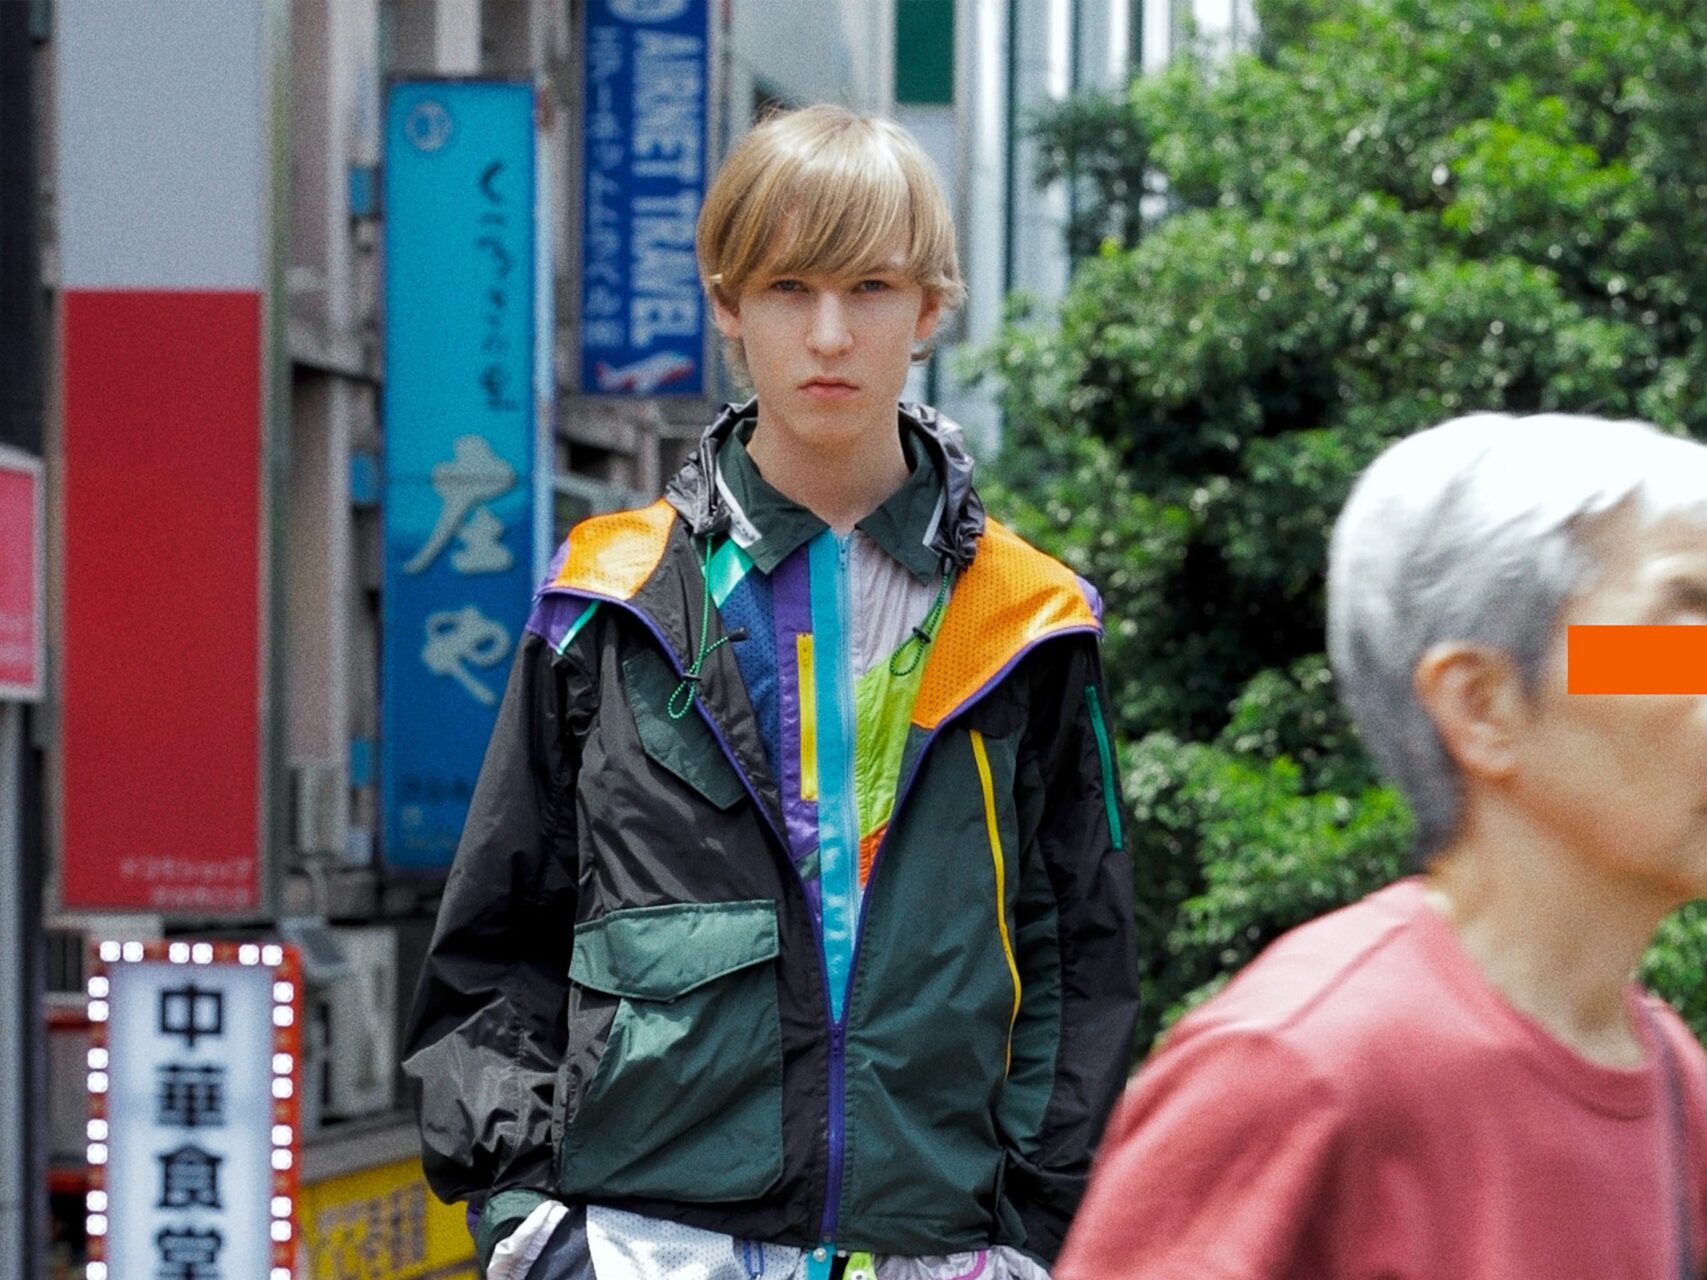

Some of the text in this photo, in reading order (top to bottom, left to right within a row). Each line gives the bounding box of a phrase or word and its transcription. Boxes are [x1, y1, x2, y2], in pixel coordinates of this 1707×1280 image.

[631, 29, 700, 348] AIRNET TRAVEL
[402, 434, 517, 706] 庄や
